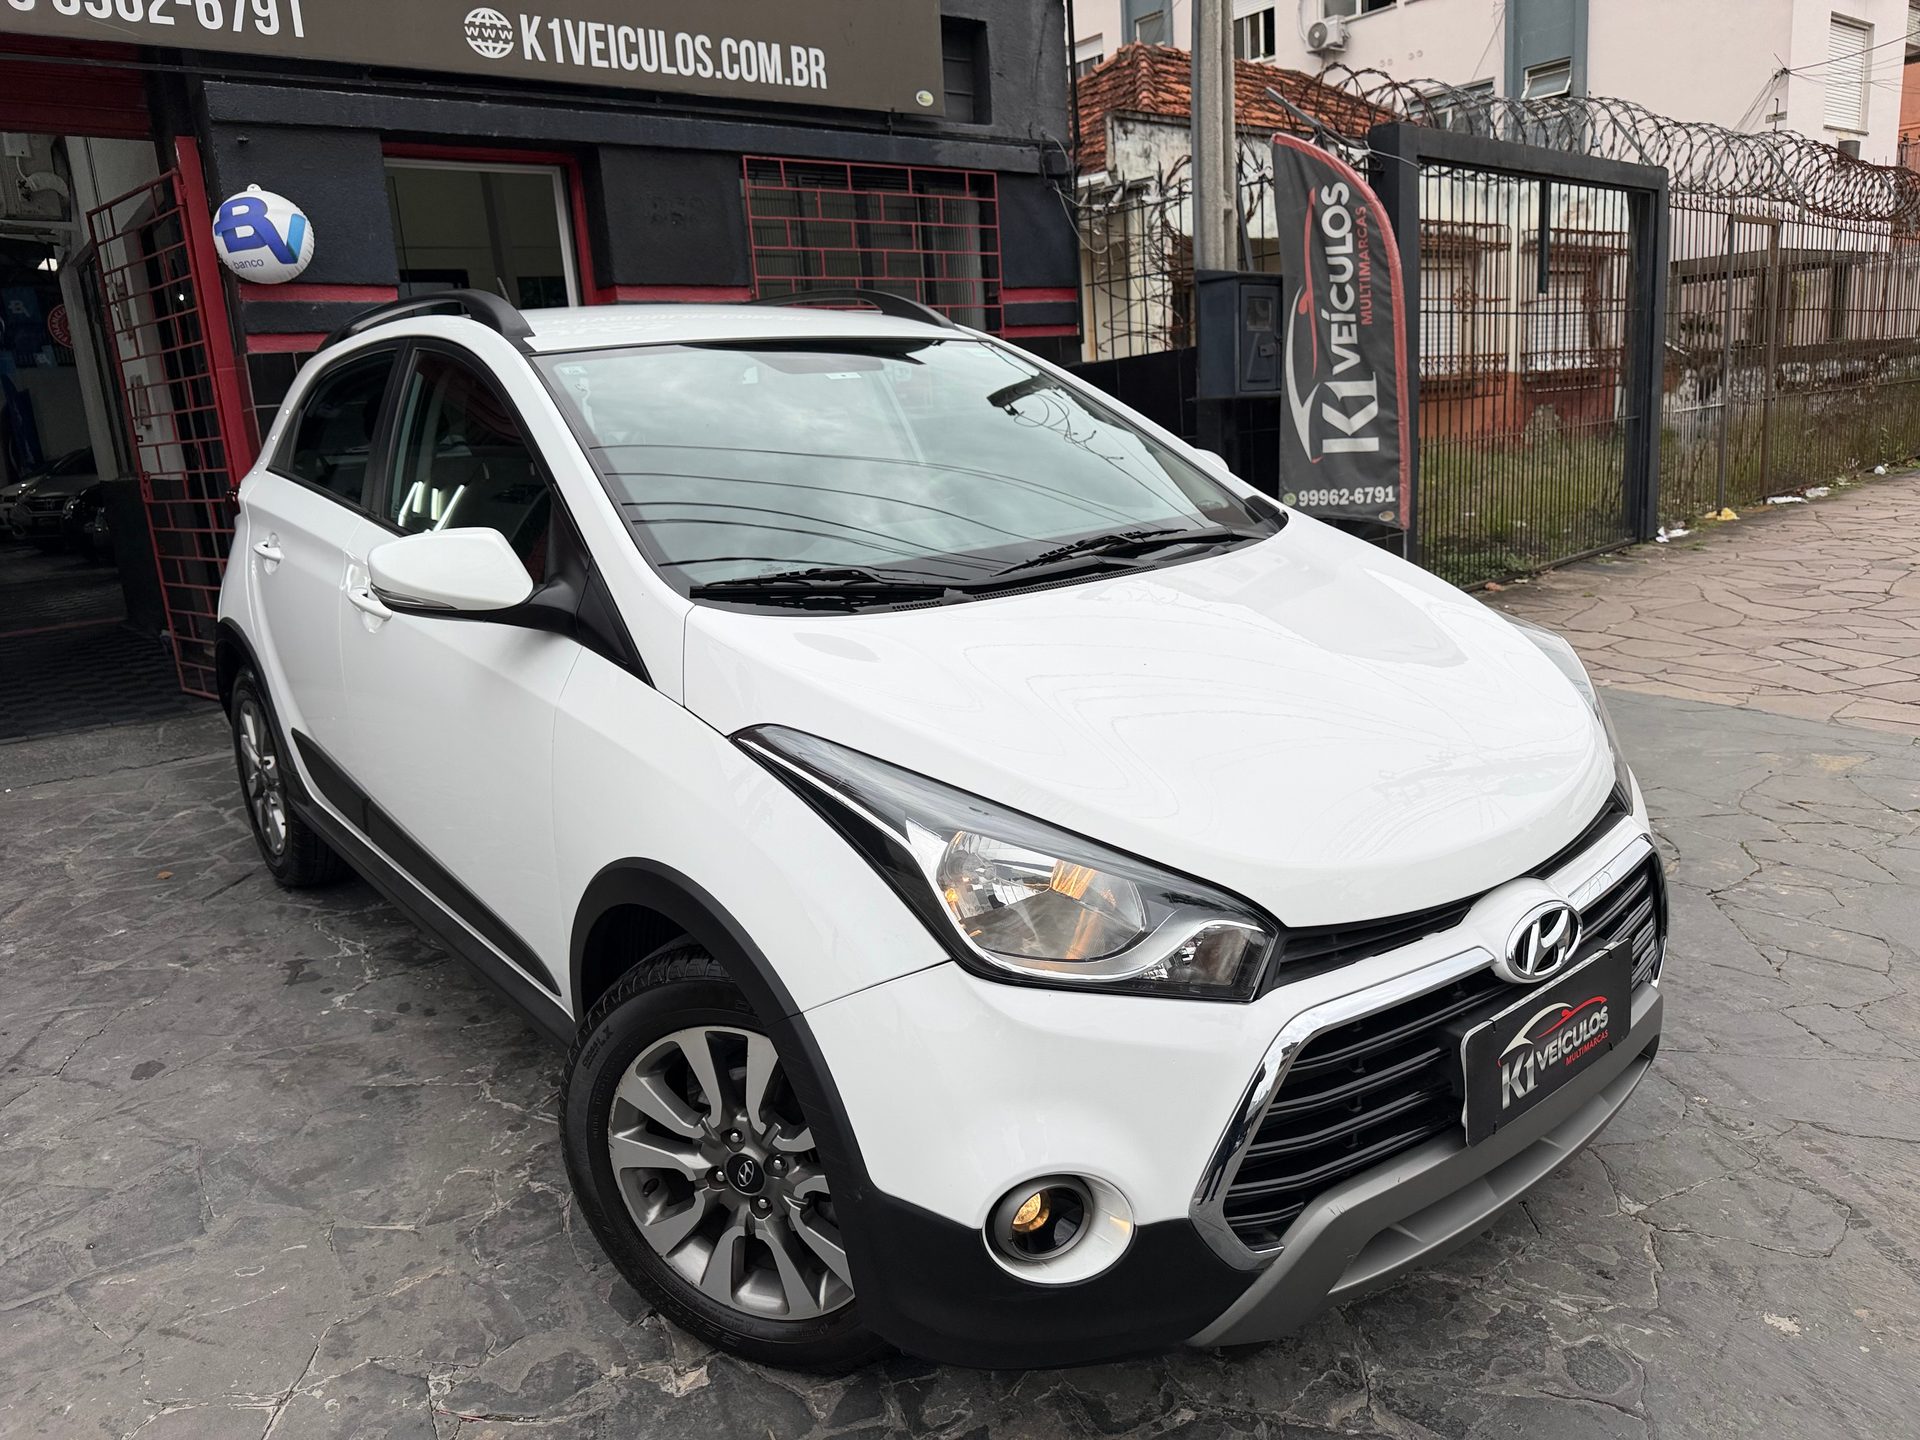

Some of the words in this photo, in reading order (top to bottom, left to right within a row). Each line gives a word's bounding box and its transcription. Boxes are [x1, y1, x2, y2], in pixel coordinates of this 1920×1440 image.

[213, 196, 306, 265] BV
[233, 259, 264, 270] banco
[1355, 206, 1373, 326] MULTIMARCAS
[1320, 182, 1361, 376] VEÍCULOS
[1321, 371, 1380, 453] K1
[1298, 485, 1396, 507] 99962-6791
[1502, 1048, 1539, 1110] K1
[1535, 1005, 1609, 1071] VEÍCULOS
[1565, 1029, 1609, 1066] MULTIMARCAS
